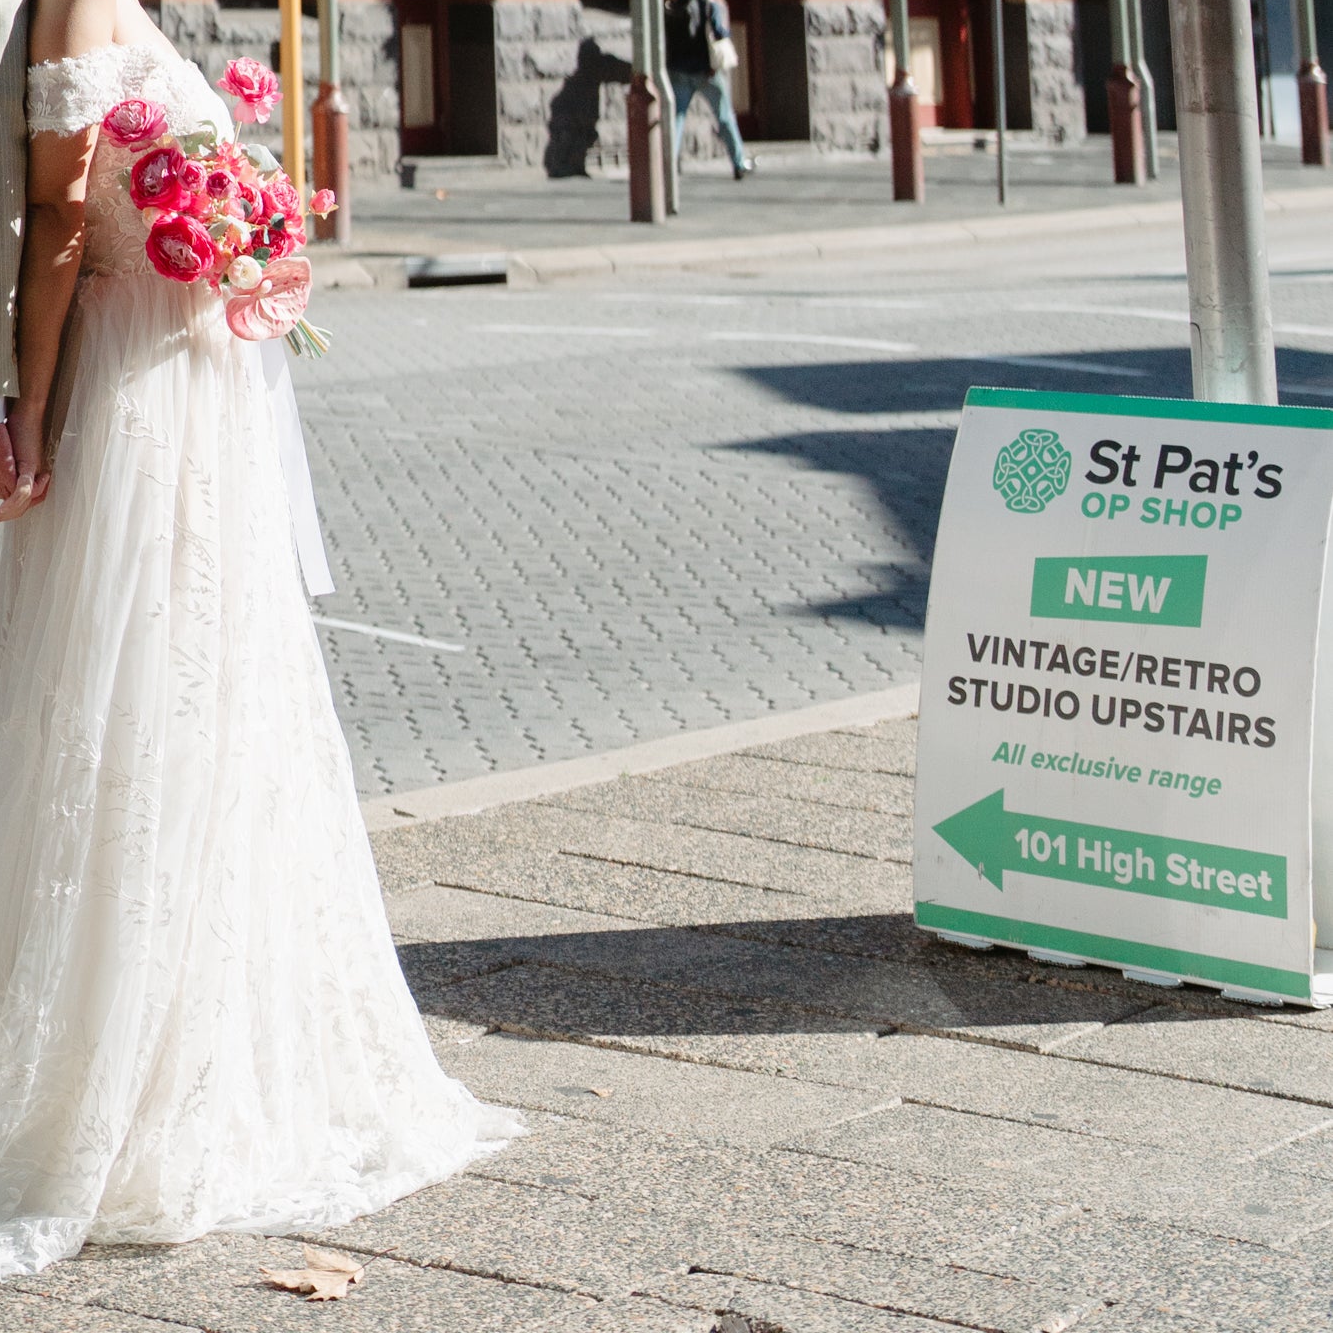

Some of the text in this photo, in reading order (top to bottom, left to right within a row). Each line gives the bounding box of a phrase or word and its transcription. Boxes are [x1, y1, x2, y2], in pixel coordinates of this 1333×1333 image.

[1085, 439, 1283, 499] St Pat's
[1081, 492, 1243, 531] OP SHOP
[1064, 567, 1172, 614] NEW
[967, 633, 1262, 698] VINTAGE/RETRO
[947, 676, 1277, 749] STUDIO UPSTAIRS
[992, 741, 1222, 797] All exclusive range
[1014, 828, 1273, 903] 101 High Street
